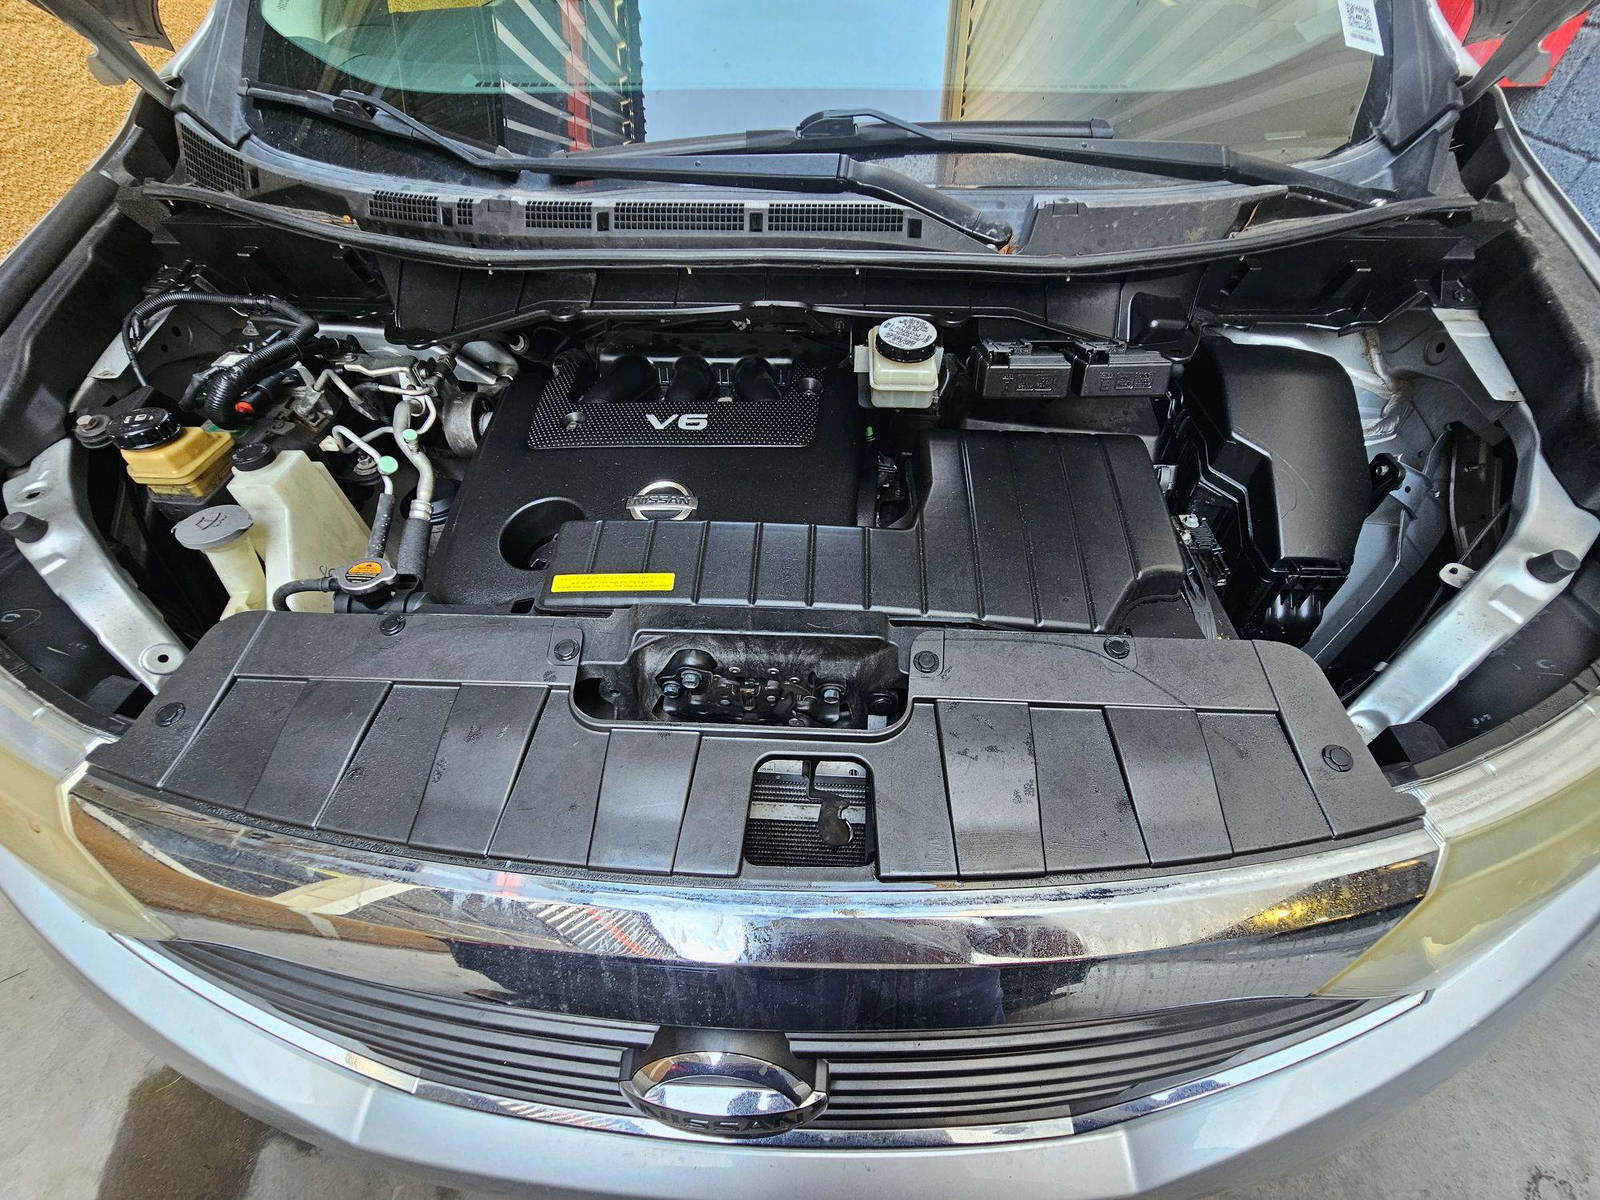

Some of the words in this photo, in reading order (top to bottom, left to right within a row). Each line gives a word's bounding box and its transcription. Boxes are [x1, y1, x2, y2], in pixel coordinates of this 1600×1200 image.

[645, 413, 709, 430] V6
[632, 495, 692, 505] NISSAN
[640, 1103, 805, 1130] NISSAN
